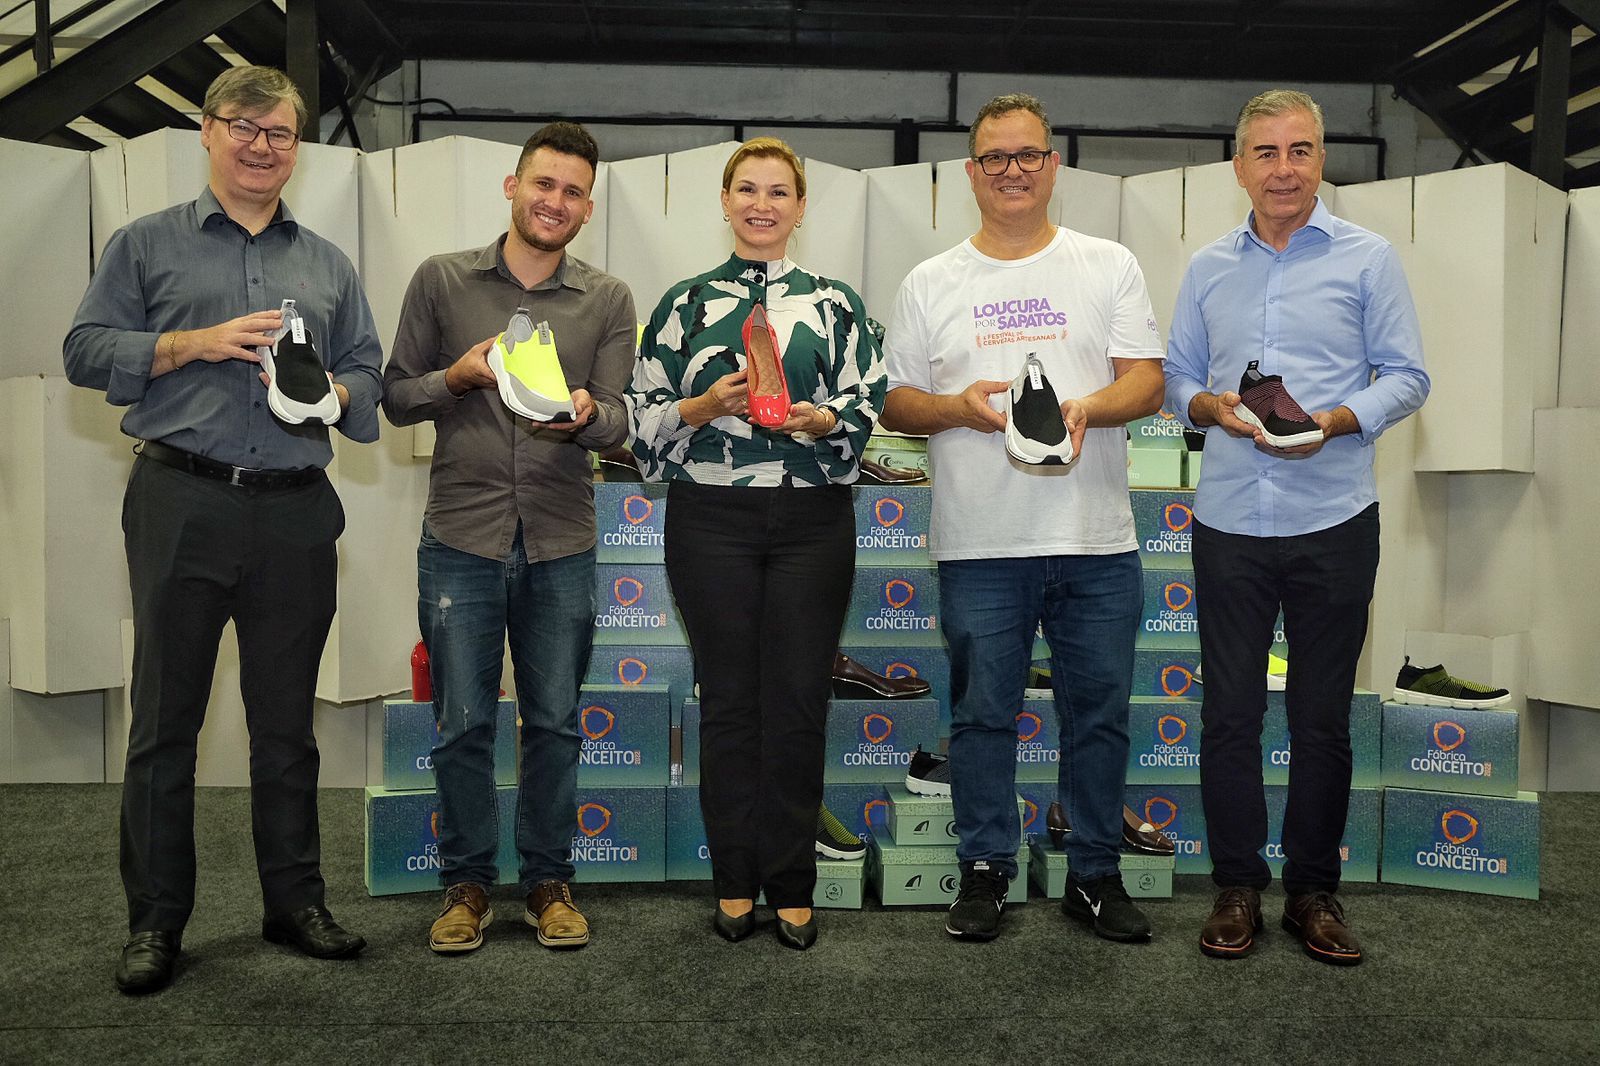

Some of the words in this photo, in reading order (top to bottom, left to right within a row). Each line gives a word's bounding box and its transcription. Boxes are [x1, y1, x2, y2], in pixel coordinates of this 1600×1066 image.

[973, 297, 1051, 319] LOUCURA
[975, 319, 996, 328] POR
[997, 312, 1067, 331] SAPATOS
[983, 337, 1015, 346] CERVEJAS
[1016, 333, 1057, 342] ARTESANAIS
[988, 331, 1015, 340] FESTIVAL
[1153, 418, 1184, 427] Fábric
[1141, 425, 1184, 437] CONCEI
[618, 523, 653, 533] Fábrica
[870, 526, 905, 536] Fábrica
[856, 535, 920, 548] CONCEITO
[1146, 539, 1192, 553] CONCEI
[609, 605, 644, 615] Fábrica
[880, 607, 915, 617] Fábrica
[1159, 610, 1193, 620] Fábrica
[594, 614, 660, 628] CONCEITO
[866, 617, 930, 630] CONCEITO
[1145, 619, 1198, 632] CONCEIT
[580, 739, 615, 750] ábrica
[858, 742, 893, 753] Fábrica
[1016, 740, 1043, 750] brica
[1153, 744, 1189, 754] Fábrica
[578, 750, 635, 765] NCEITO
[843, 752, 910, 766] CONCEITO
[1427, 749, 1466, 762] Fábrica
[1411, 757, 1484, 776] CONCEITO
[571, 836, 612, 847] Fábrica
[566, 847, 631, 862] ONCEITO
[1435, 841, 1479, 857] Fábrica
[1416, 850, 1500, 874] CONCEITO
